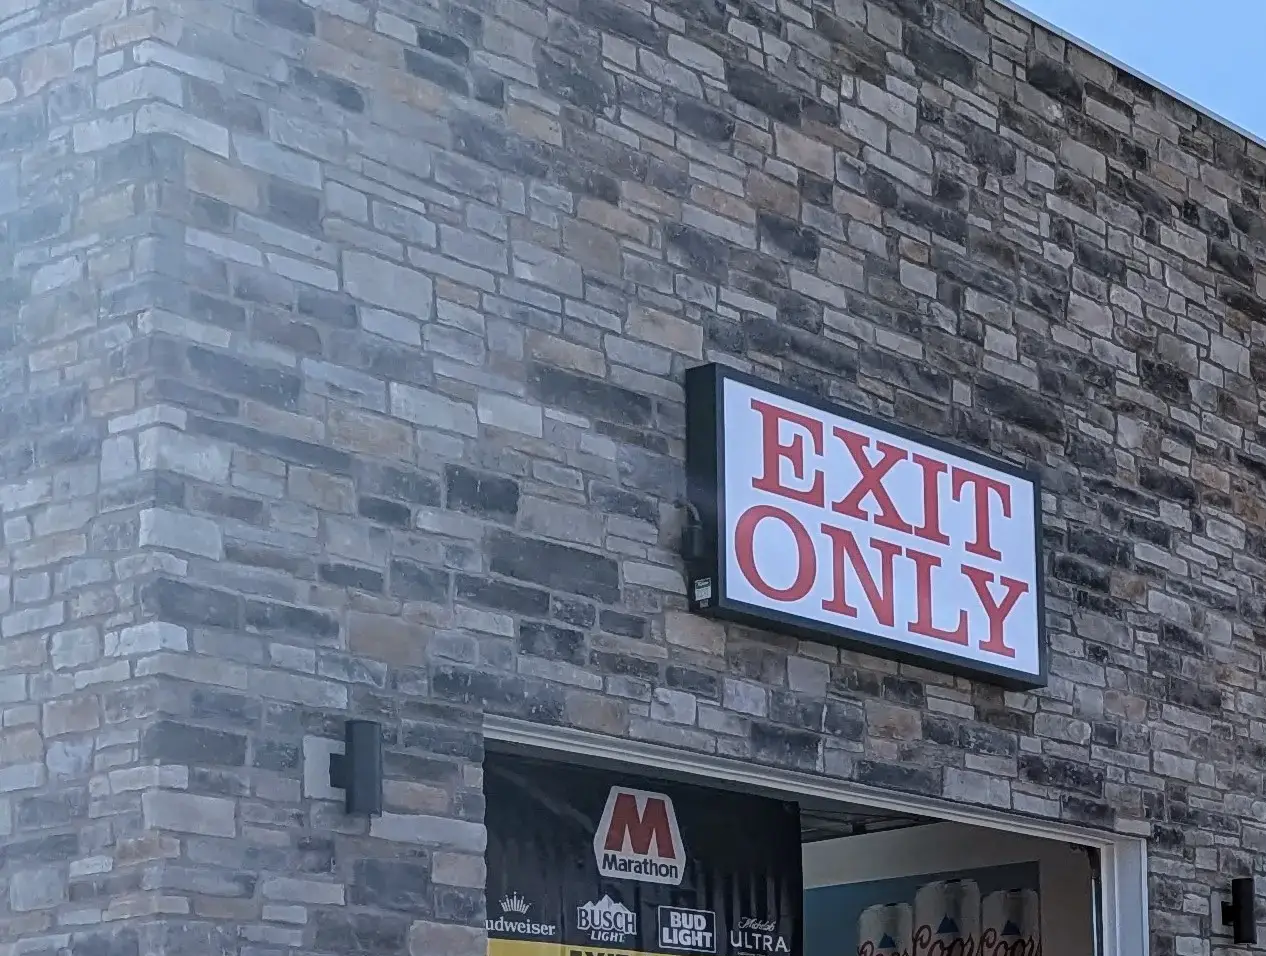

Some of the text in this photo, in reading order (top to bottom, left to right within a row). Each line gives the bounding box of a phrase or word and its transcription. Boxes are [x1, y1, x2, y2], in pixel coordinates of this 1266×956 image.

[750, 398, 1011, 561] EXIT
[734, 504, 1029, 658] ONLY
[604, 792, 676, 859] M
[602, 853, 679, 879] Marathon
[485, 916, 555, 935] udweiser
[578, 907, 637, 935] BUSCH
[670, 911, 697, 930] BUD
[591, 930, 624, 942] LIGHT
[662, 927, 713, 948] LIGHT
[730, 930, 789, 952] ULTRA
